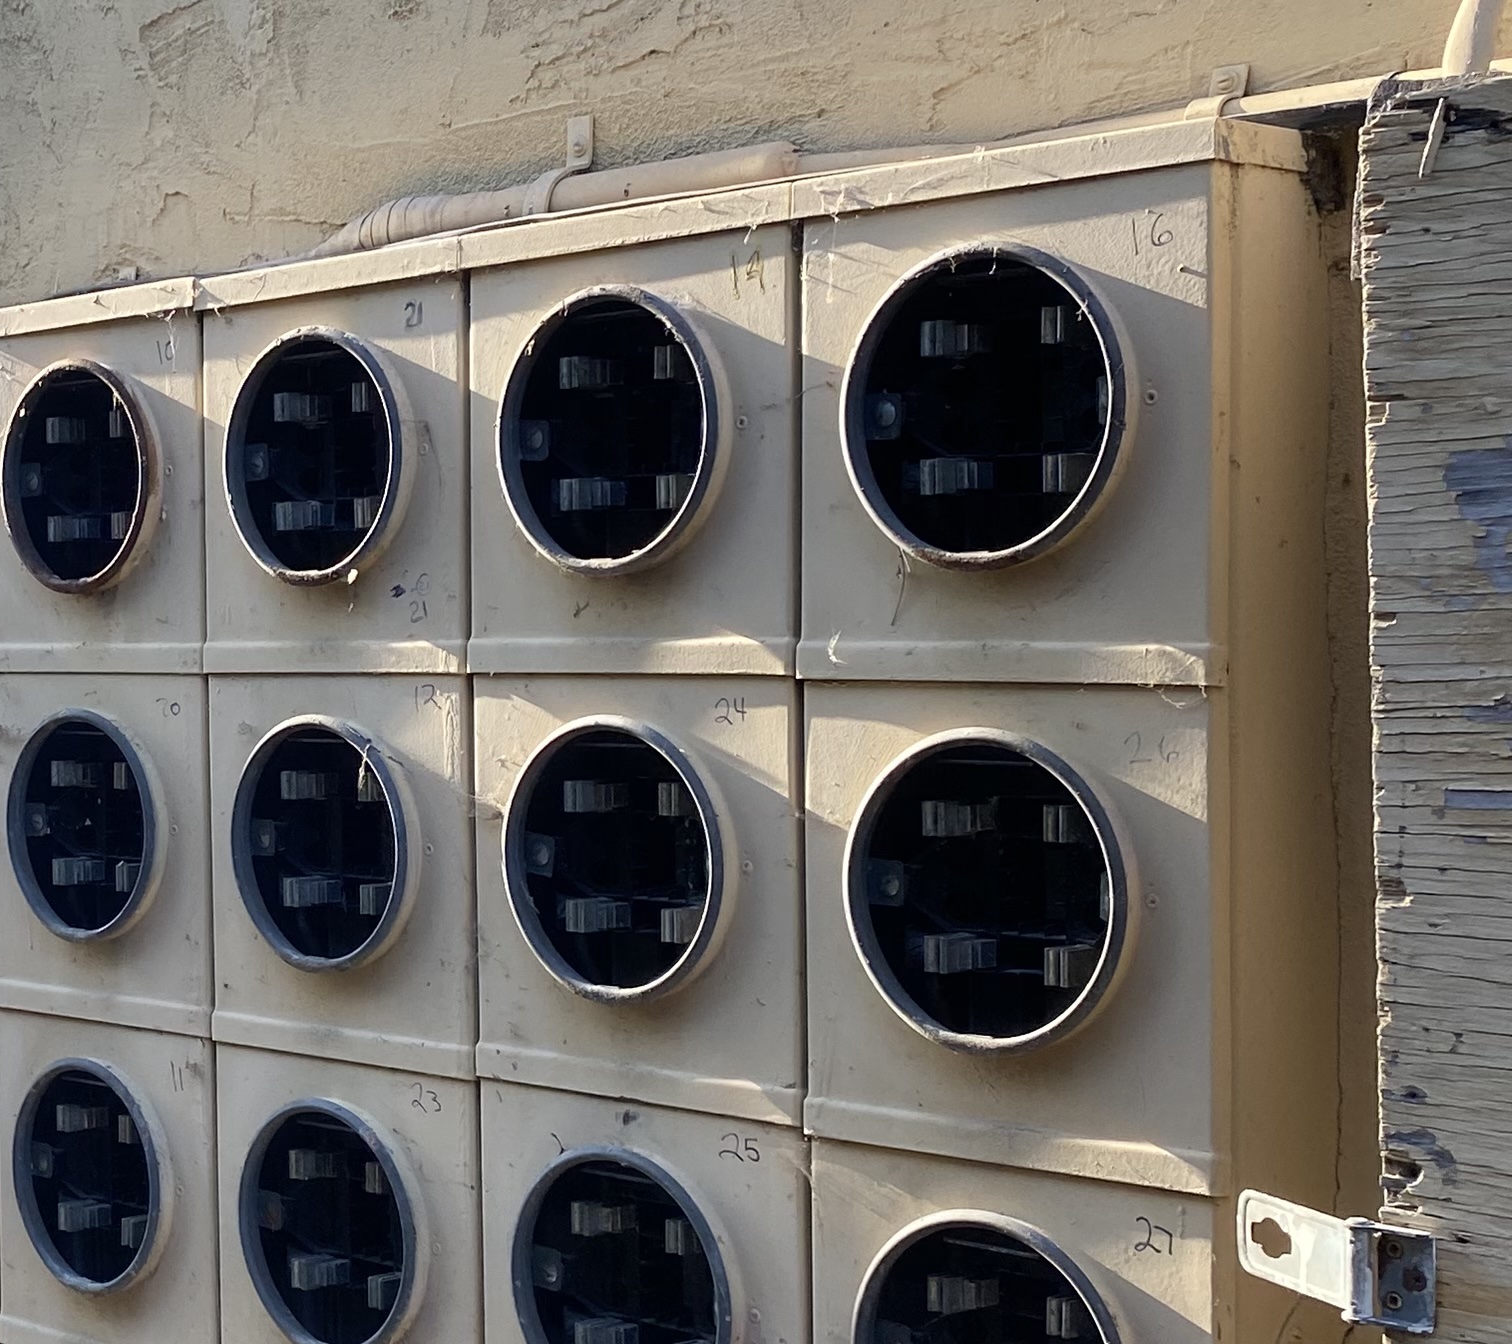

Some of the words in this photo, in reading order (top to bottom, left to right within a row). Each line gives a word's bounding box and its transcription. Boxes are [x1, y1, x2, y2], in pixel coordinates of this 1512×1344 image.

[1131, 213, 1174, 257] 16
[404, 299, 423, 329] 21
[409, 600, 428, 623] 21
[414, 683, 441, 715] 12
[714, 697, 748, 726] 24
[410, 1082, 442, 1114] 23
[719, 1133, 760, 1163] 25
[1134, 1216, 1173, 1255] 27
